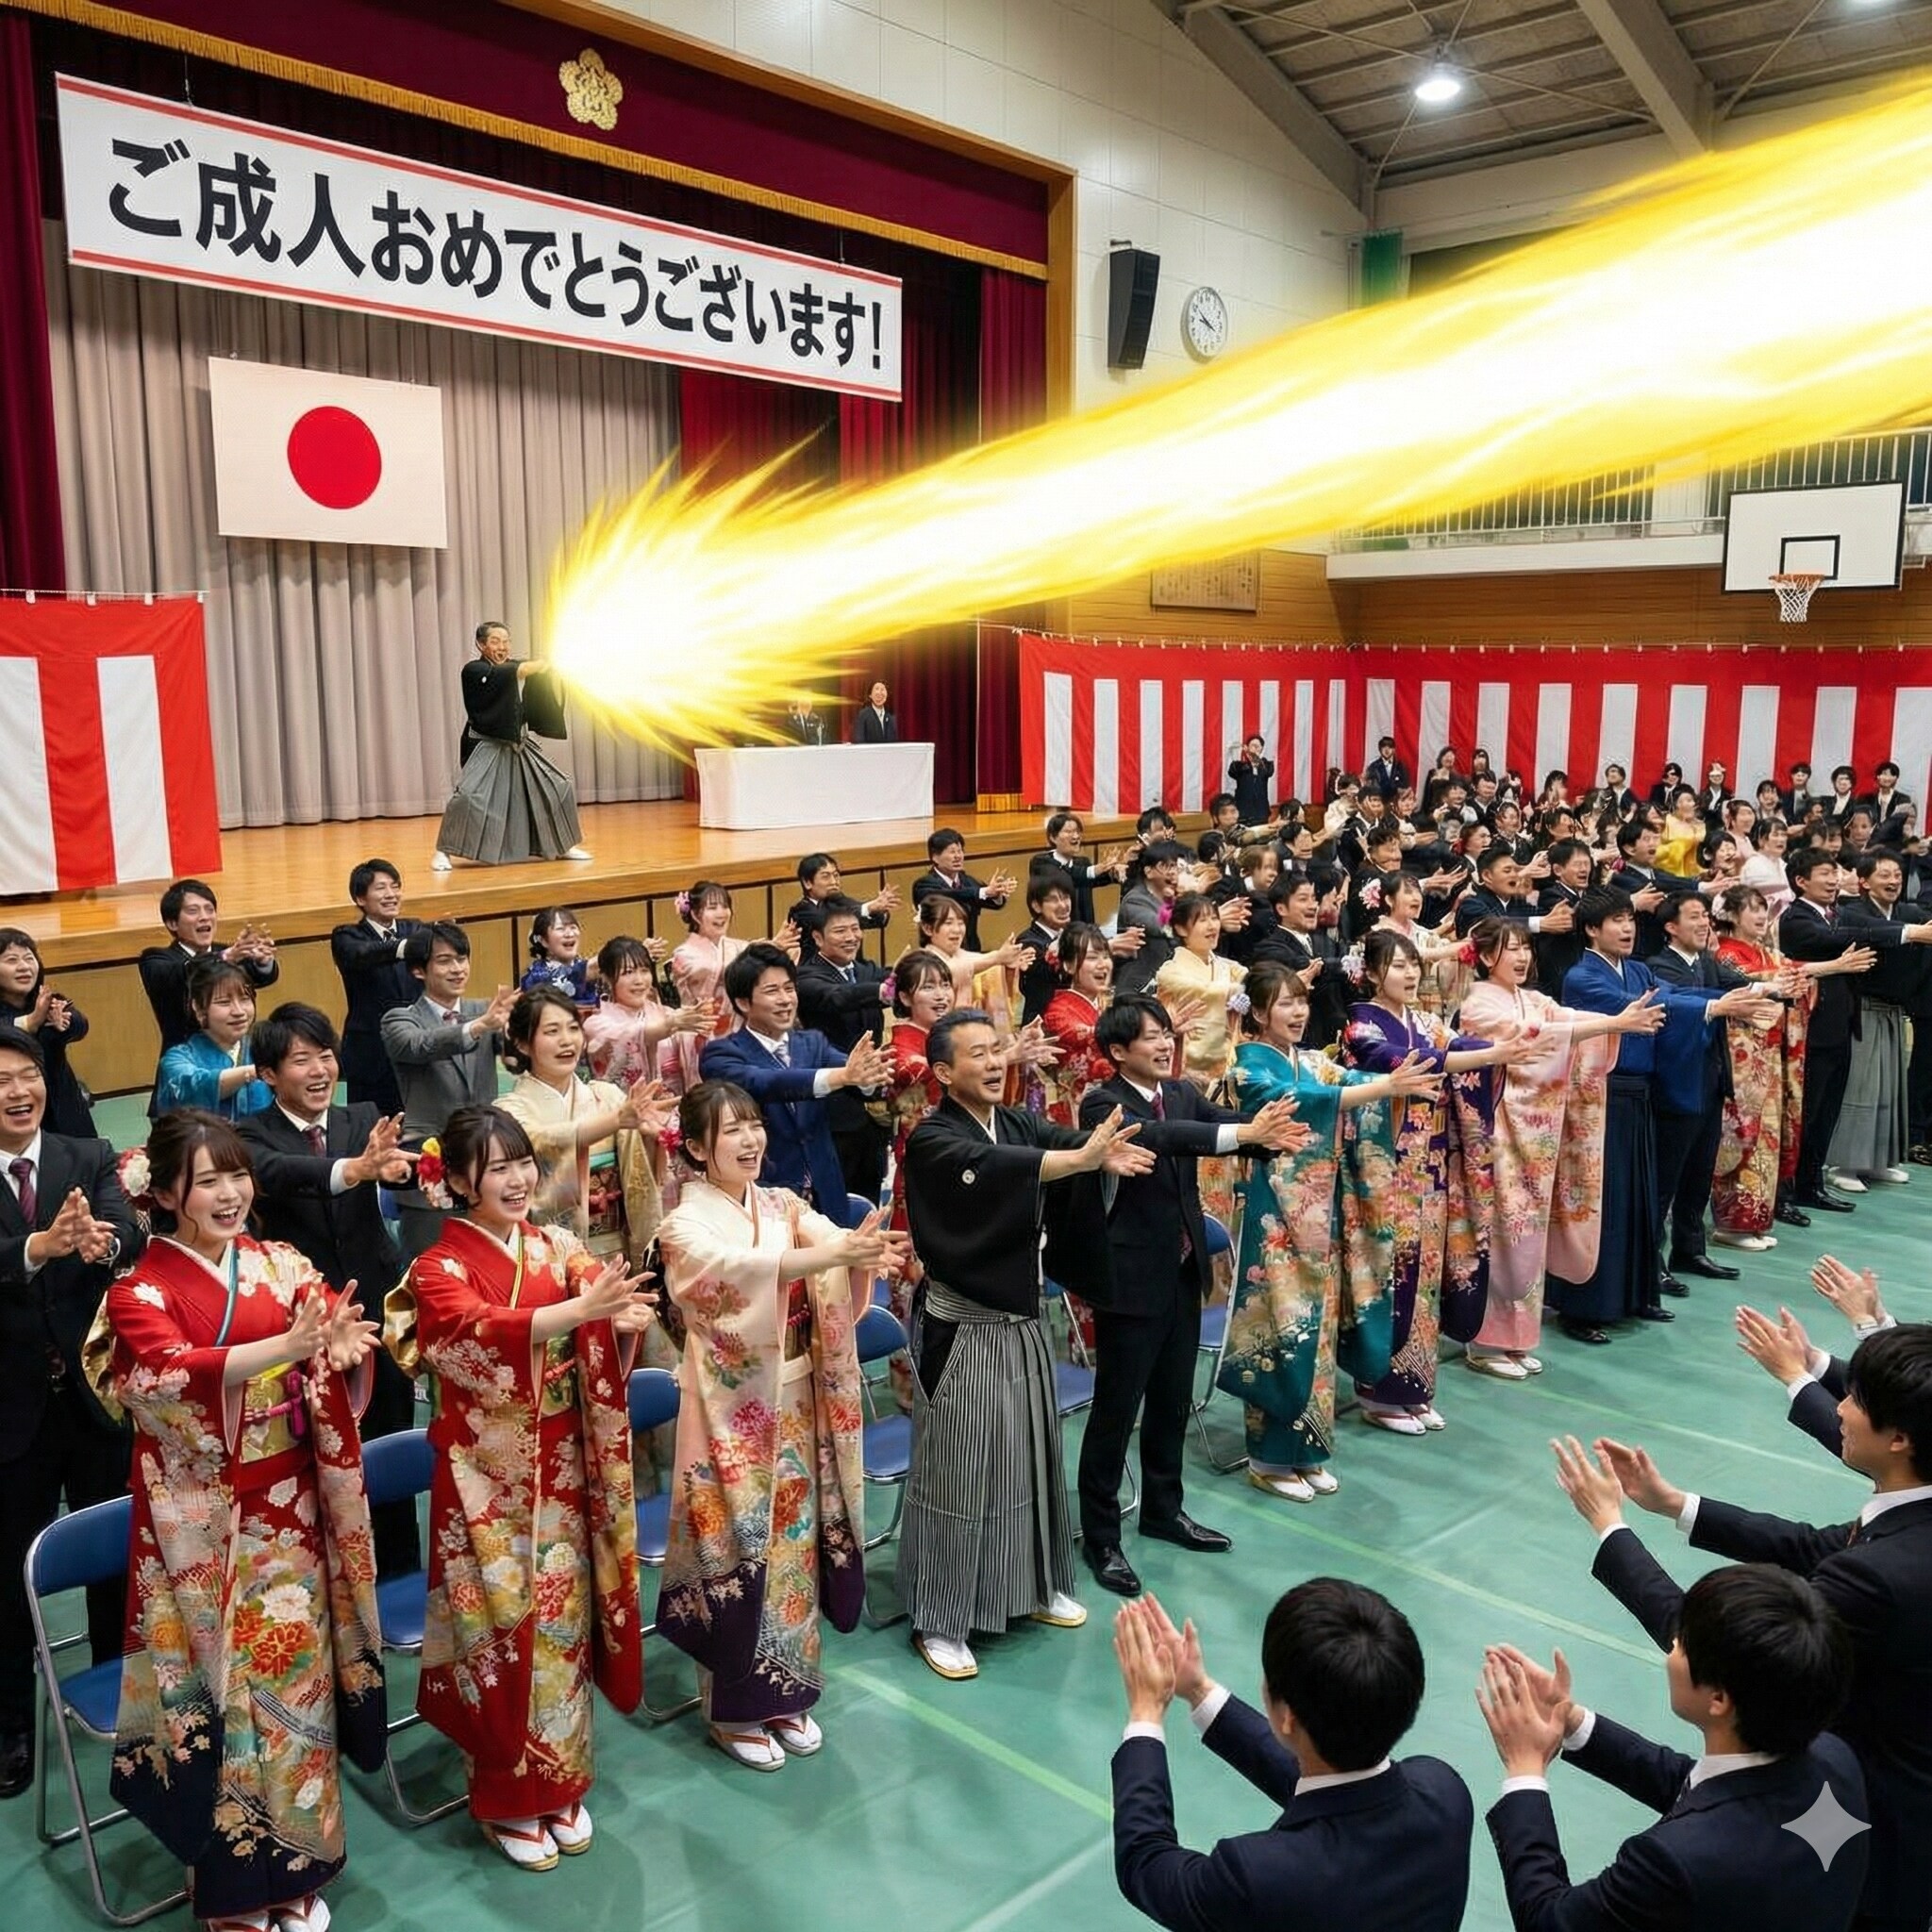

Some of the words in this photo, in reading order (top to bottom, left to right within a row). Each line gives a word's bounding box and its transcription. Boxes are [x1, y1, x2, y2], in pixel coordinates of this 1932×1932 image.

[108, 137, 881, 369] ご成人おめでとうございます!
